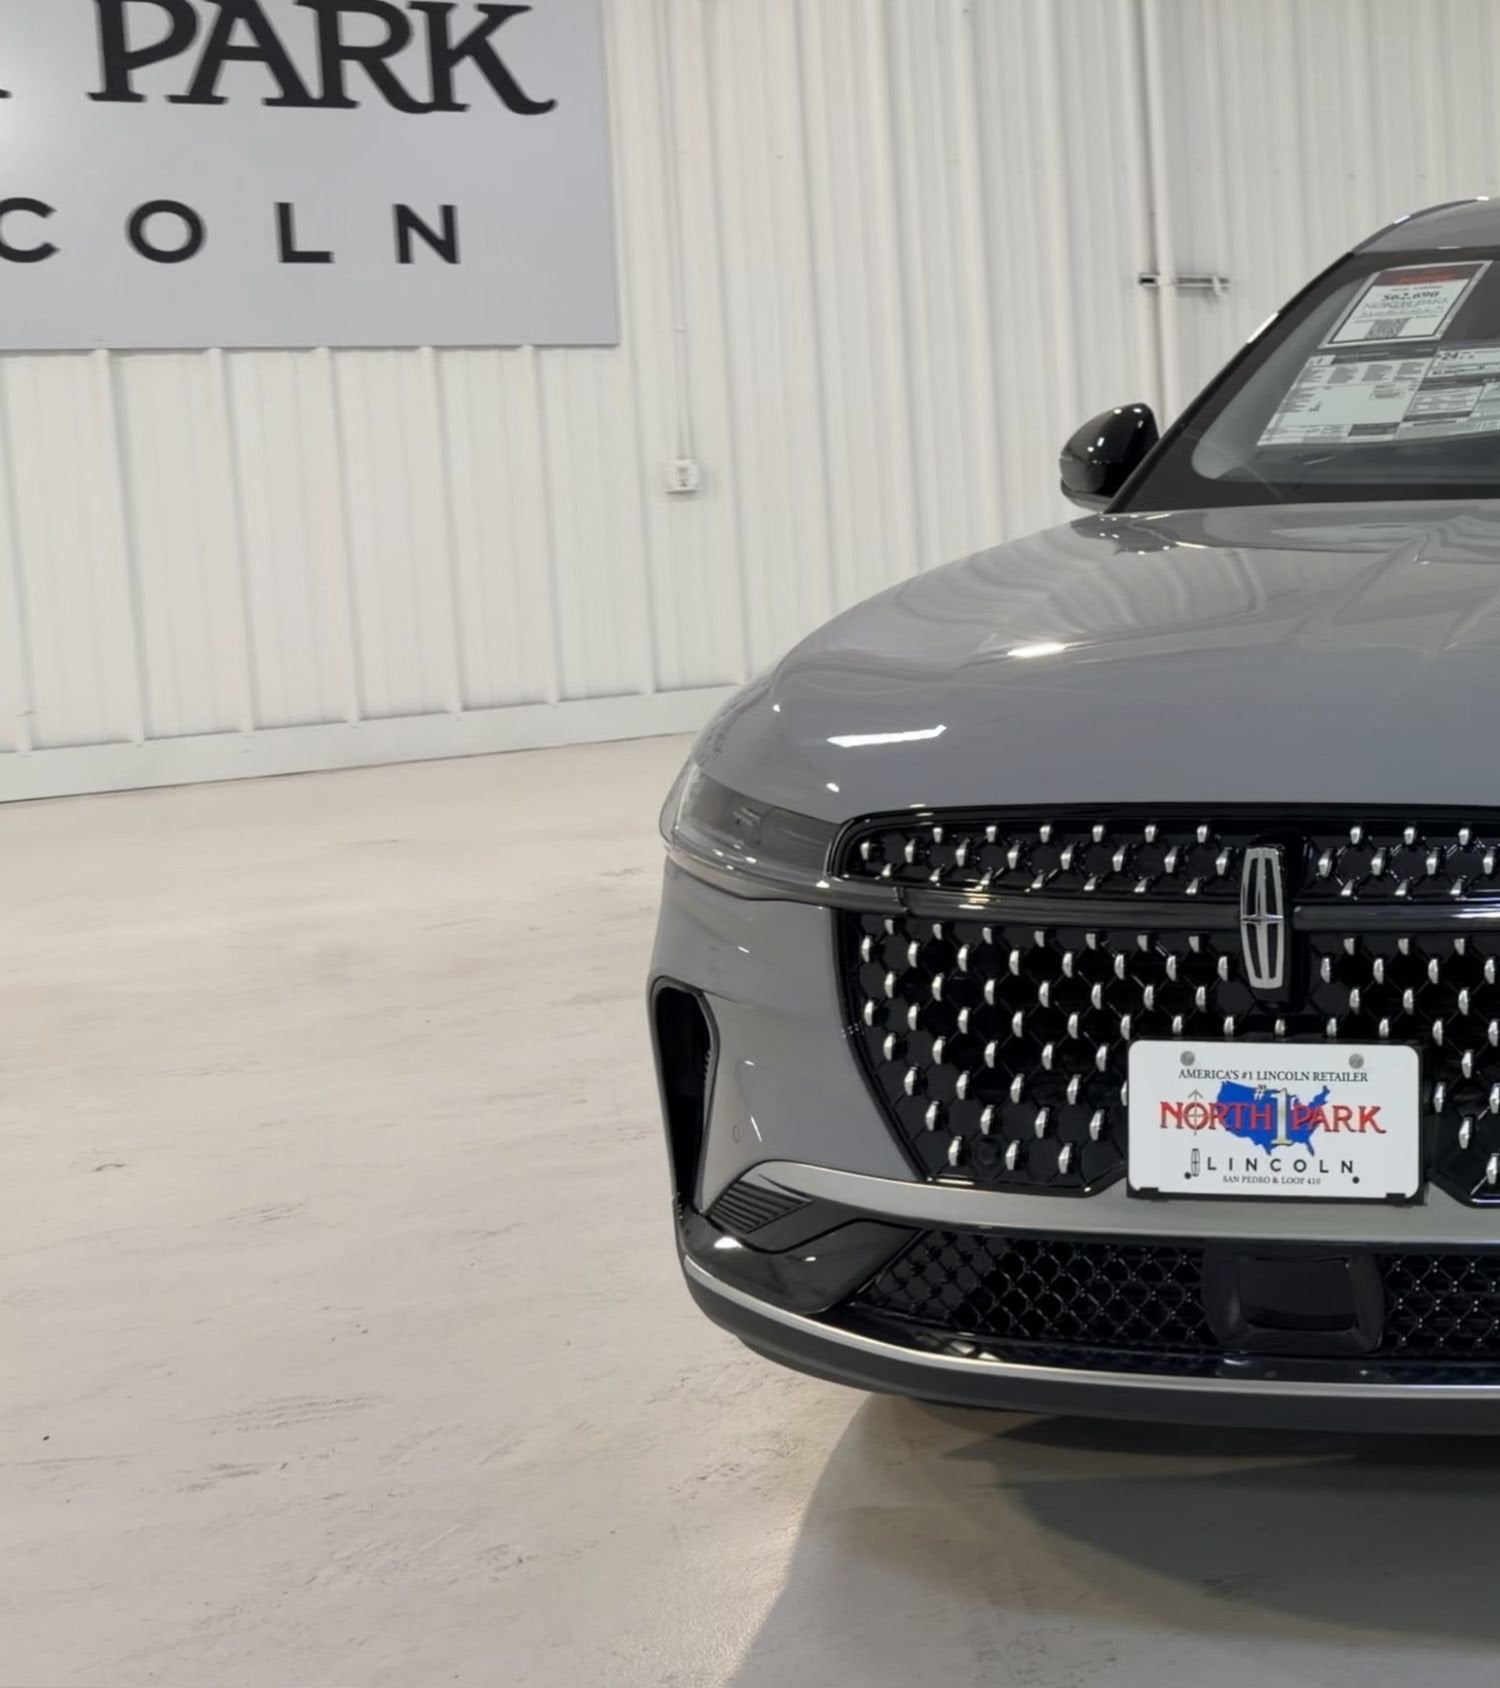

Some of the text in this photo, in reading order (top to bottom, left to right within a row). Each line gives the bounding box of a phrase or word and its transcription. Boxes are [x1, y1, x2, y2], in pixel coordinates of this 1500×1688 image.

[87, 0, 557, 115] PARK
[1179, 1068, 1368, 1082] AMERICA'S #1 LINCOLN RETAILER
[1159, 1101, 1387, 1134] NORTH PARK
[1207, 1156, 1353, 1174] LINCOLN
[1222, 1175, 1240, 1184] SAN
[1241, 1176, 1271, 1185] PEDRO
